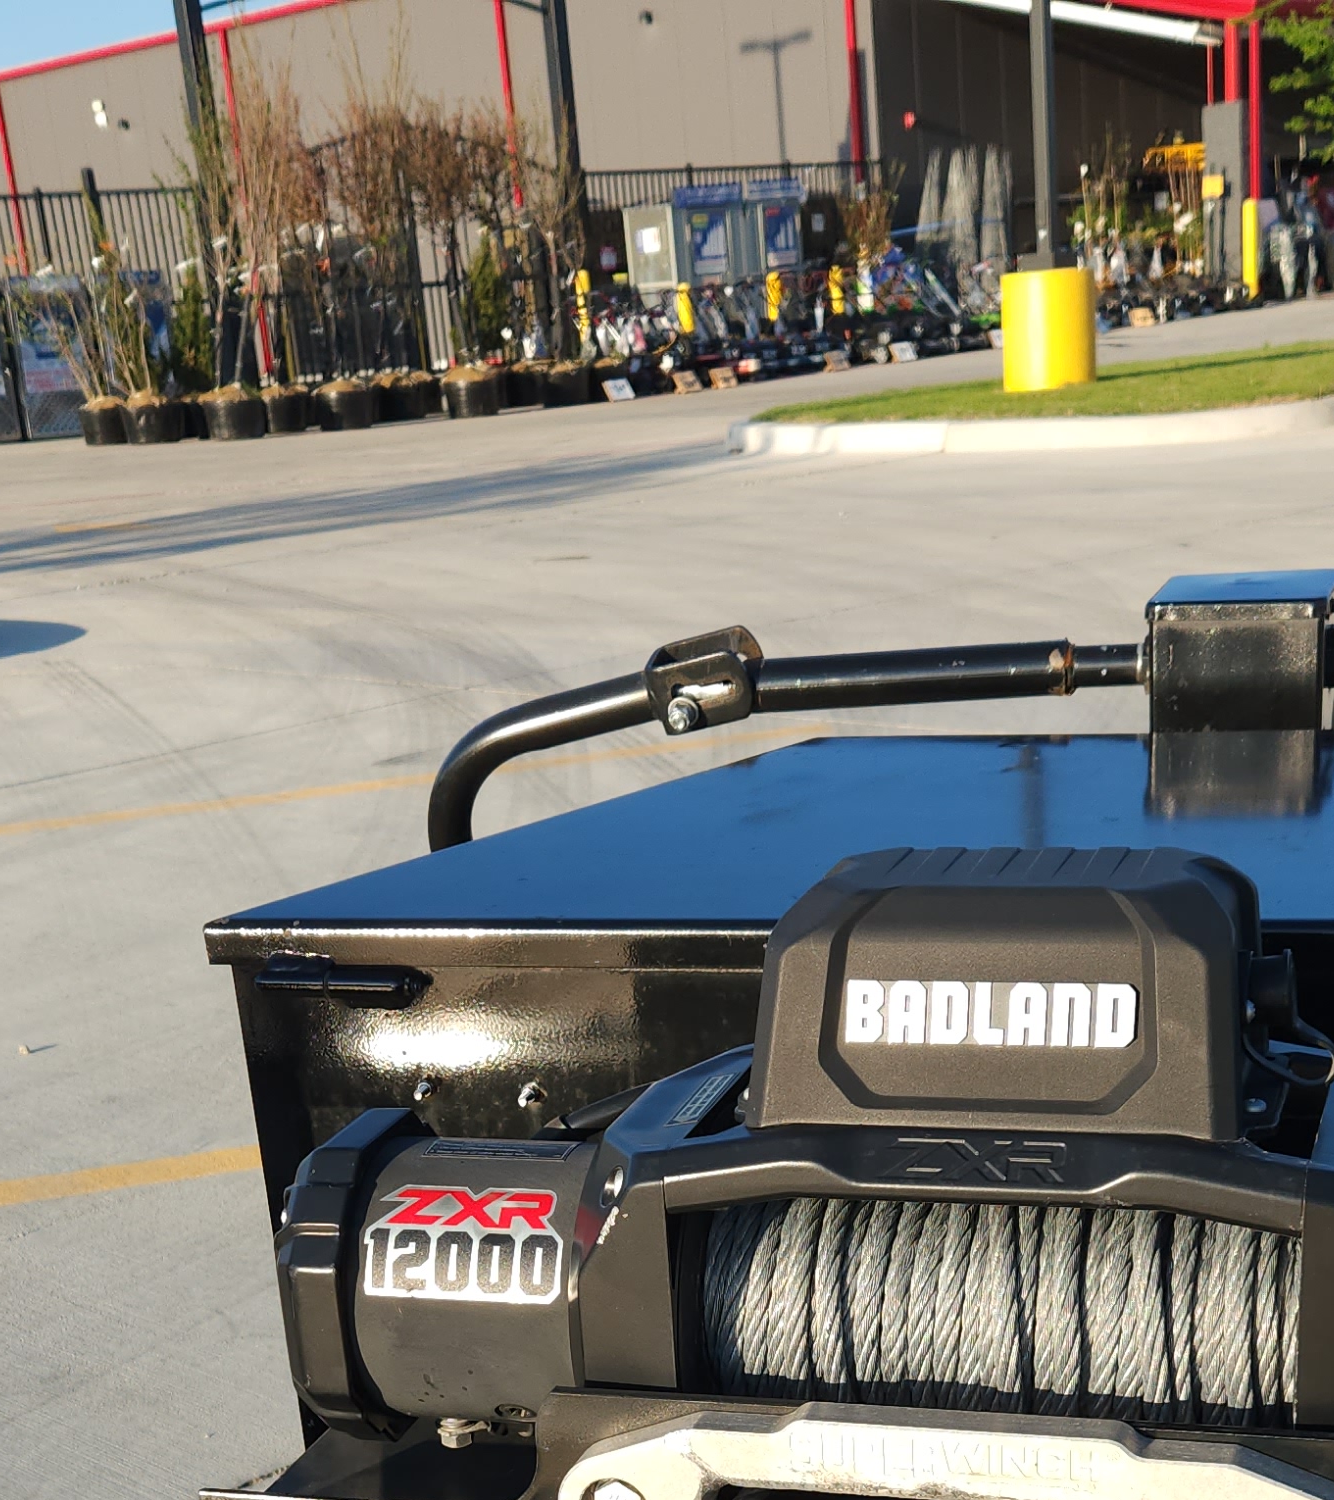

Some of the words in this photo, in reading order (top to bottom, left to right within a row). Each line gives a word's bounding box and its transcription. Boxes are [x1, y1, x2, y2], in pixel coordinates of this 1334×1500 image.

[845, 979, 1140, 1048] BADLAND
[875, 1137, 1067, 1184] ZXR
[382, 1187, 556, 1230] ZXR
[368, 1227, 559, 1297] 12000
